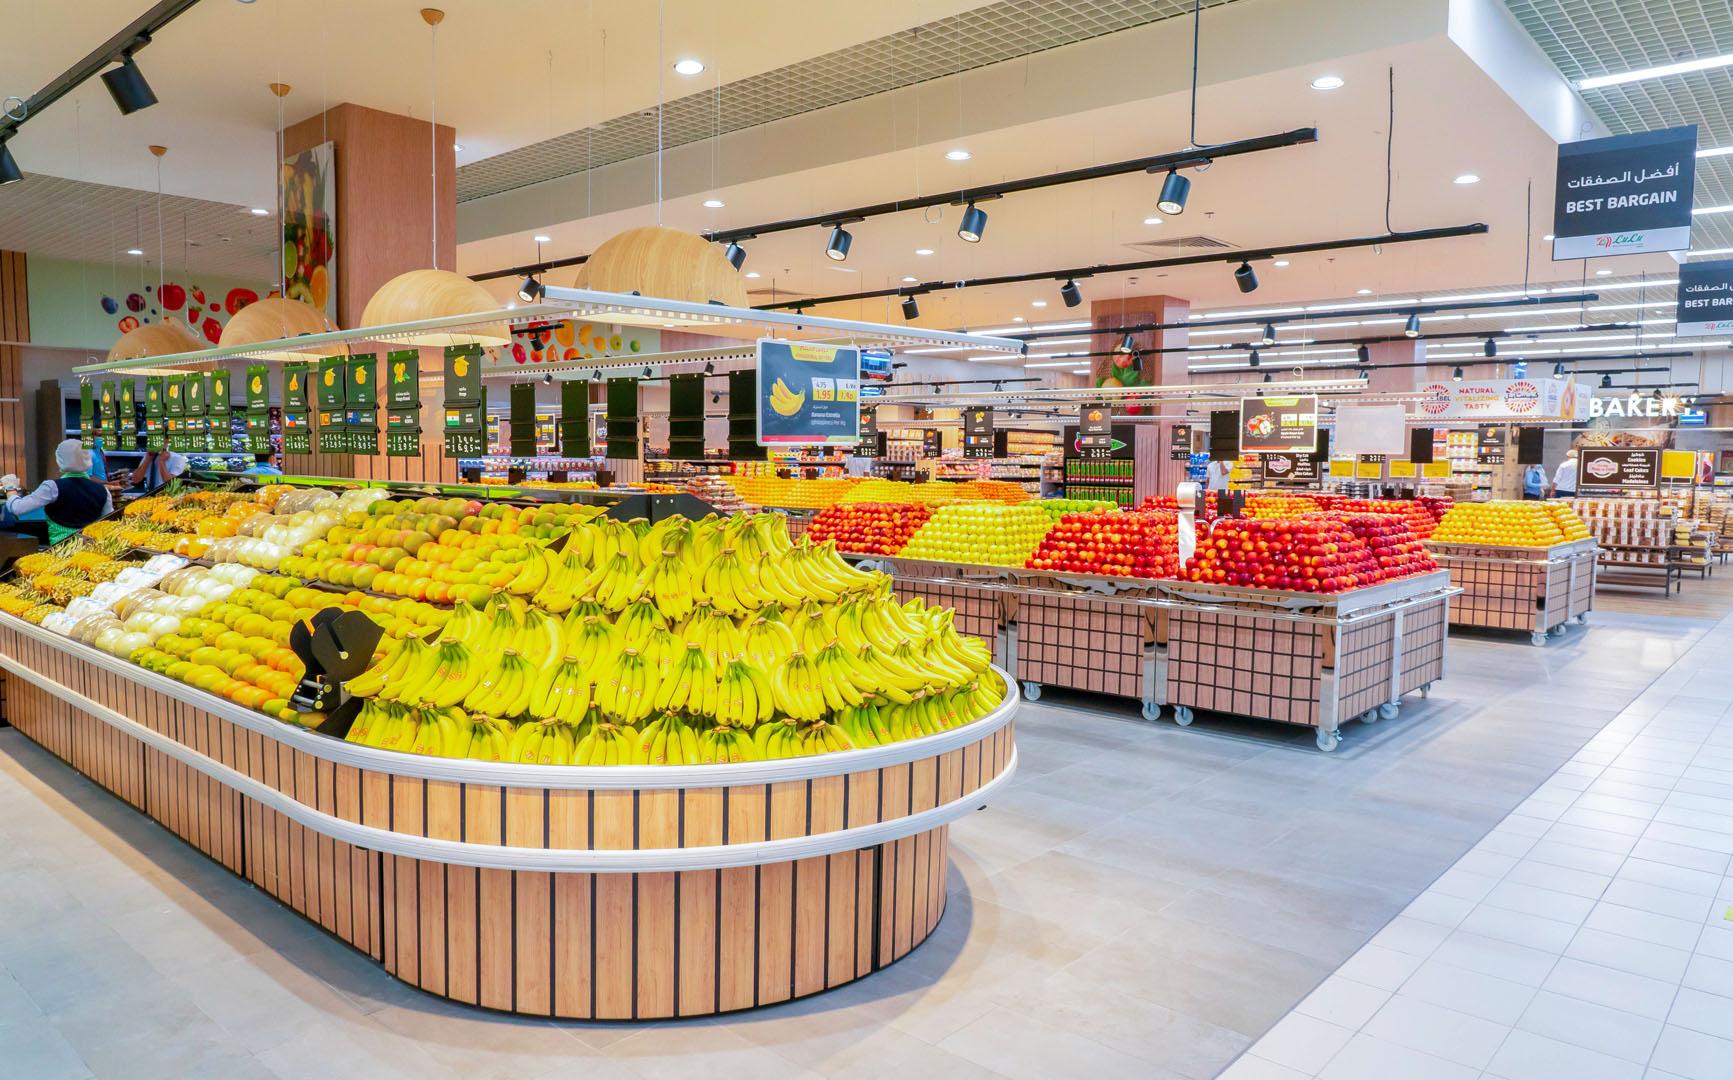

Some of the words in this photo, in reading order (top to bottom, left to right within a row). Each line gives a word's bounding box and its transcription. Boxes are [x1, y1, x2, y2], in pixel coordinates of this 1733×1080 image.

[1567, 171, 1631, 189] الصفقات
[1634, 162, 1680, 184] أفضل
[1566, 198, 1604, 214] BEST
[1607, 190, 1677, 210] BARGAIN
[1684, 299, 1710, 308] BEST
[1712, 297, 1733, 307] BAR
[816, 390, 831, 400] 1.95
